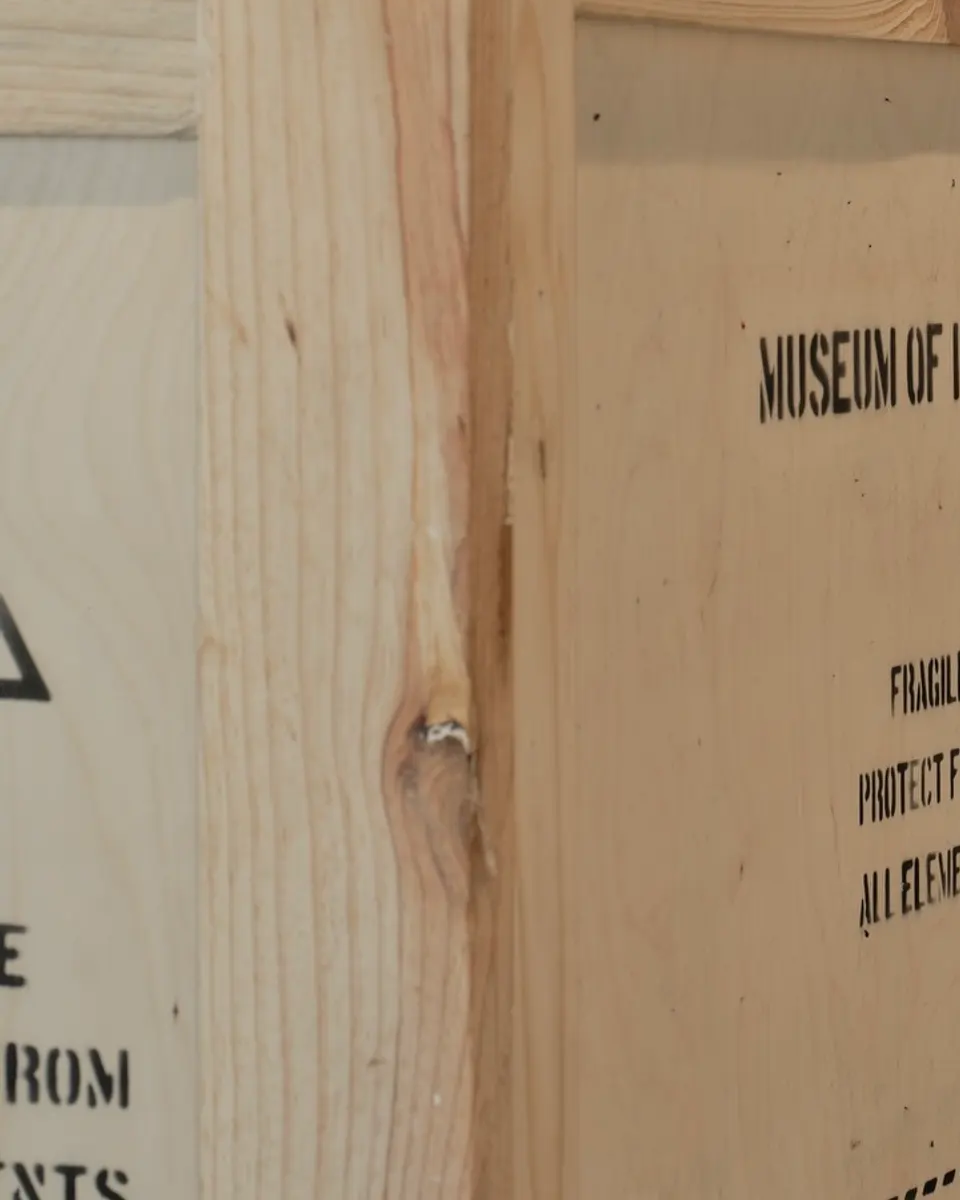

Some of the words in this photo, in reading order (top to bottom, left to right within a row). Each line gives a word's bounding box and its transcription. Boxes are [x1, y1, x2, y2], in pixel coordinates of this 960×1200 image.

[759, 327, 897, 424] MUSEUM
[906, 322, 943, 406] OF
[858, 751, 945, 826] PROTECT
[859, 872, 895, 929] ALL
[0, 1160, 129, 1200] NTS
